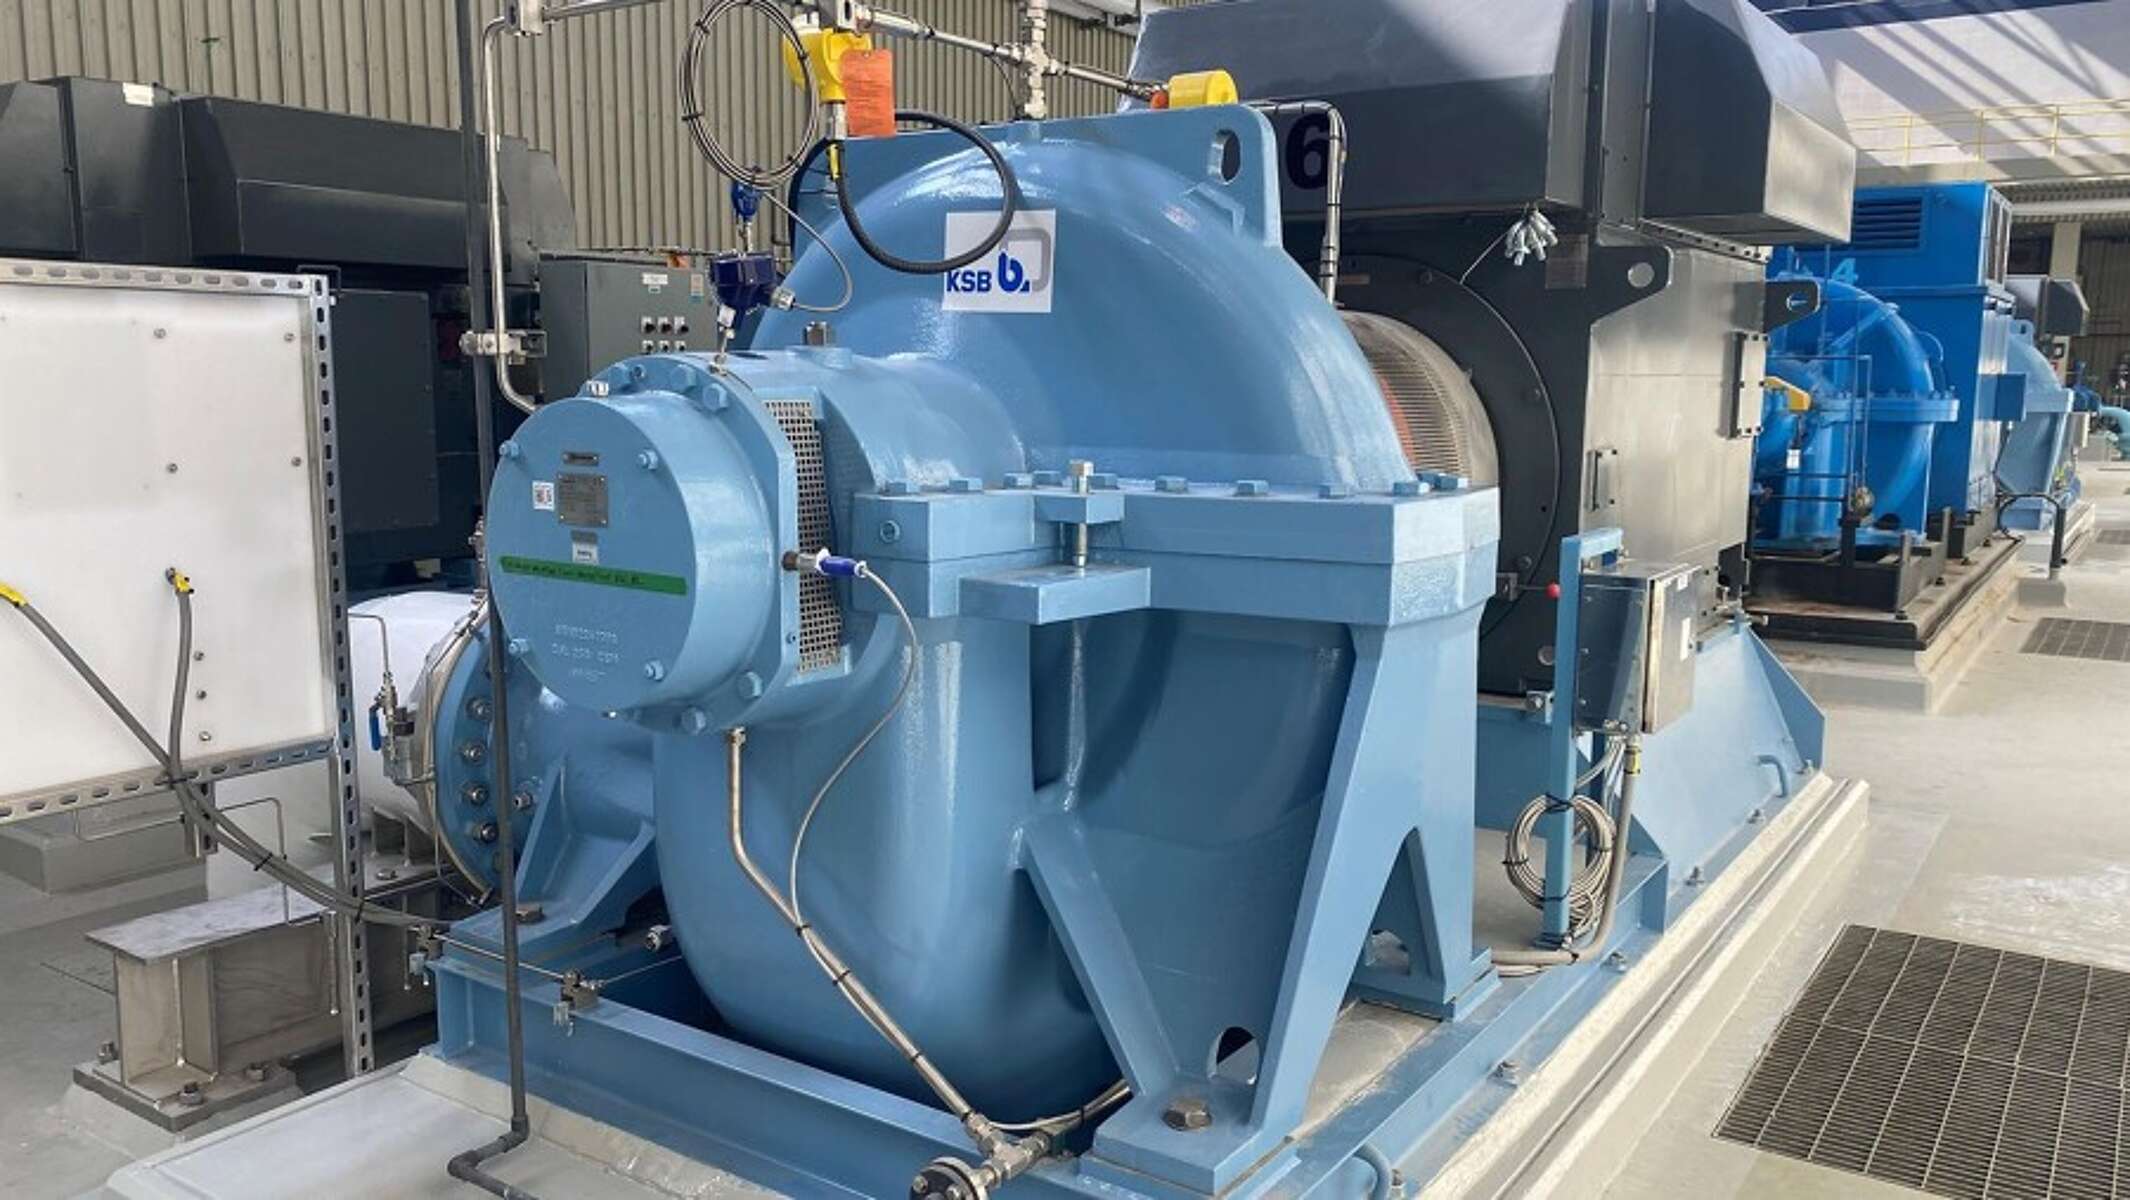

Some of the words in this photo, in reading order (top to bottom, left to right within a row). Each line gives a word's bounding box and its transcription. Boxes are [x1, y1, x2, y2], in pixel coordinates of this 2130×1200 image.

[1286, 113, 1330, 189] 6
[946, 270, 992, 292] KSB
[1831, 257, 1859, 285] 4
